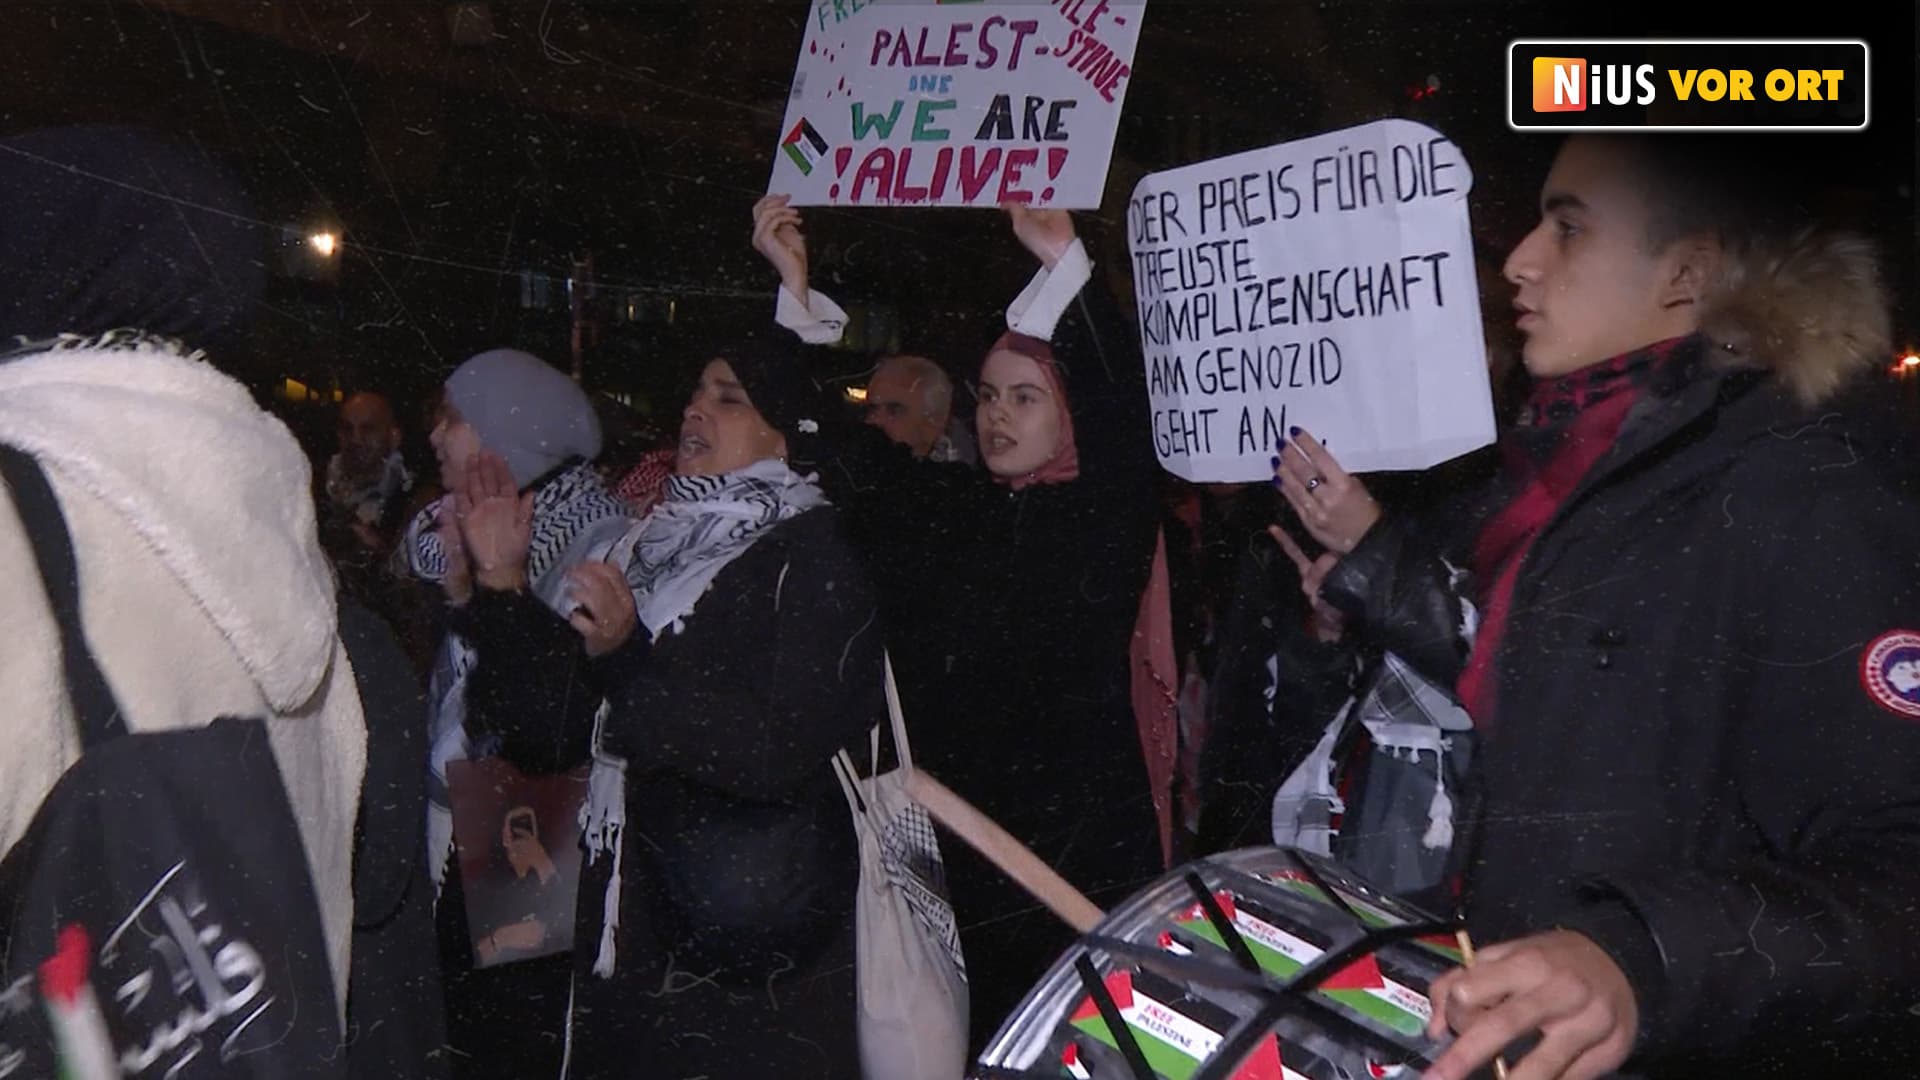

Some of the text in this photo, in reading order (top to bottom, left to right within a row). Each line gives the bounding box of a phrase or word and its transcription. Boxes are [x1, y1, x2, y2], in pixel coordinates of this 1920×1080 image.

[817, 0, 882, 32] FRE
[870, 15, 1049, 71] PALEST-
[1053, 29, 1131, 103] STINE
[851, 94, 1077, 142] WE ARE
[829, 147, 1069, 206] !ALIVE!
[1132, 136, 1457, 244] DER PREIS FÜR DIE
[1135, 238, 1258, 296] TREUSTE
[1140, 251, 1451, 346] KOMPLIZENSCHAFT
[1151, 336, 1342, 396] AM GENOZID
[1153, 408, 1219, 458] GEHT
